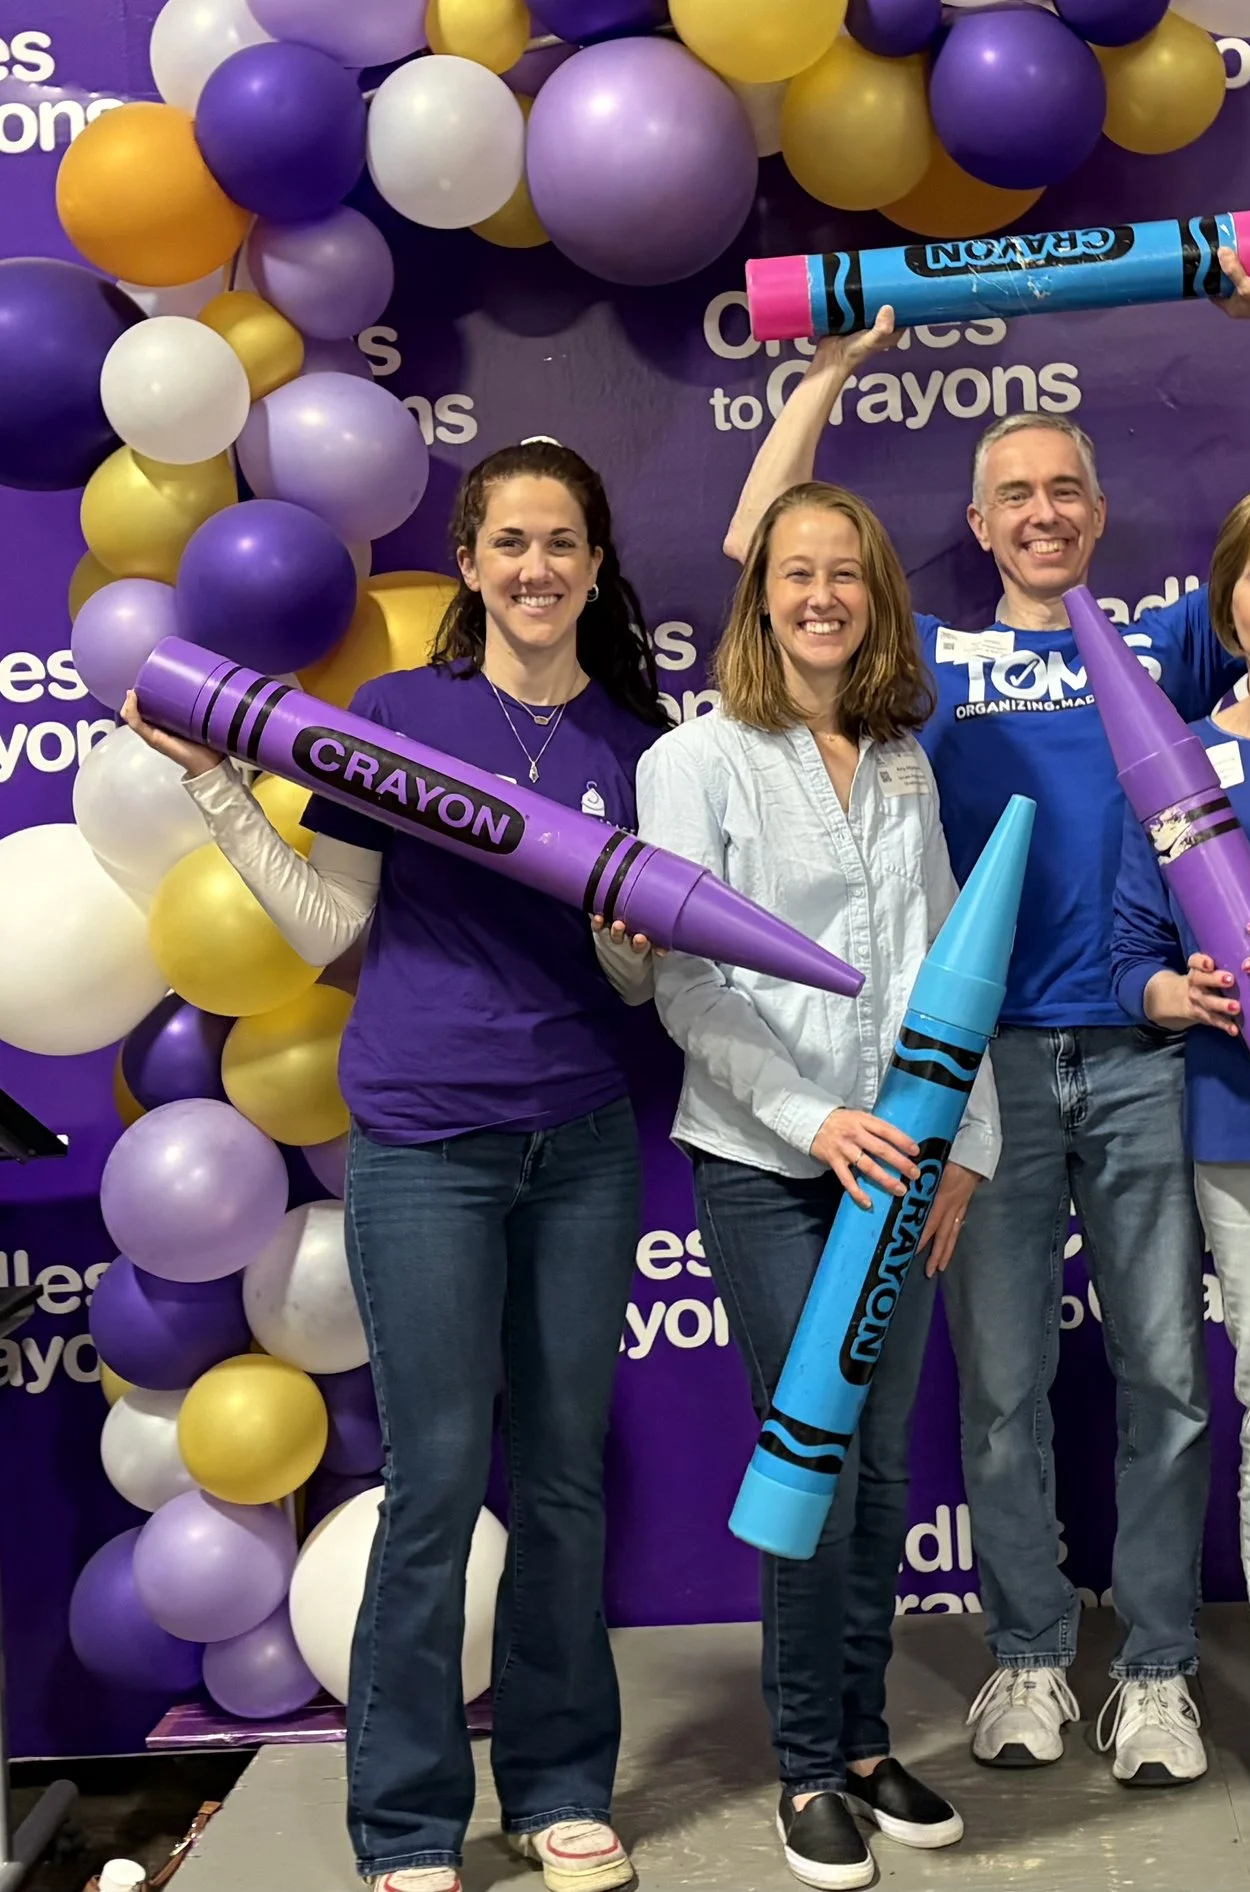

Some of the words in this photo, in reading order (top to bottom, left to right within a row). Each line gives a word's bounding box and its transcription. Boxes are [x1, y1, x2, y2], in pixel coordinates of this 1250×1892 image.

[709, 388, 763, 431] to
[308, 736, 512, 847] CRAYON
[850, 1158, 943, 1364] CRAYON
